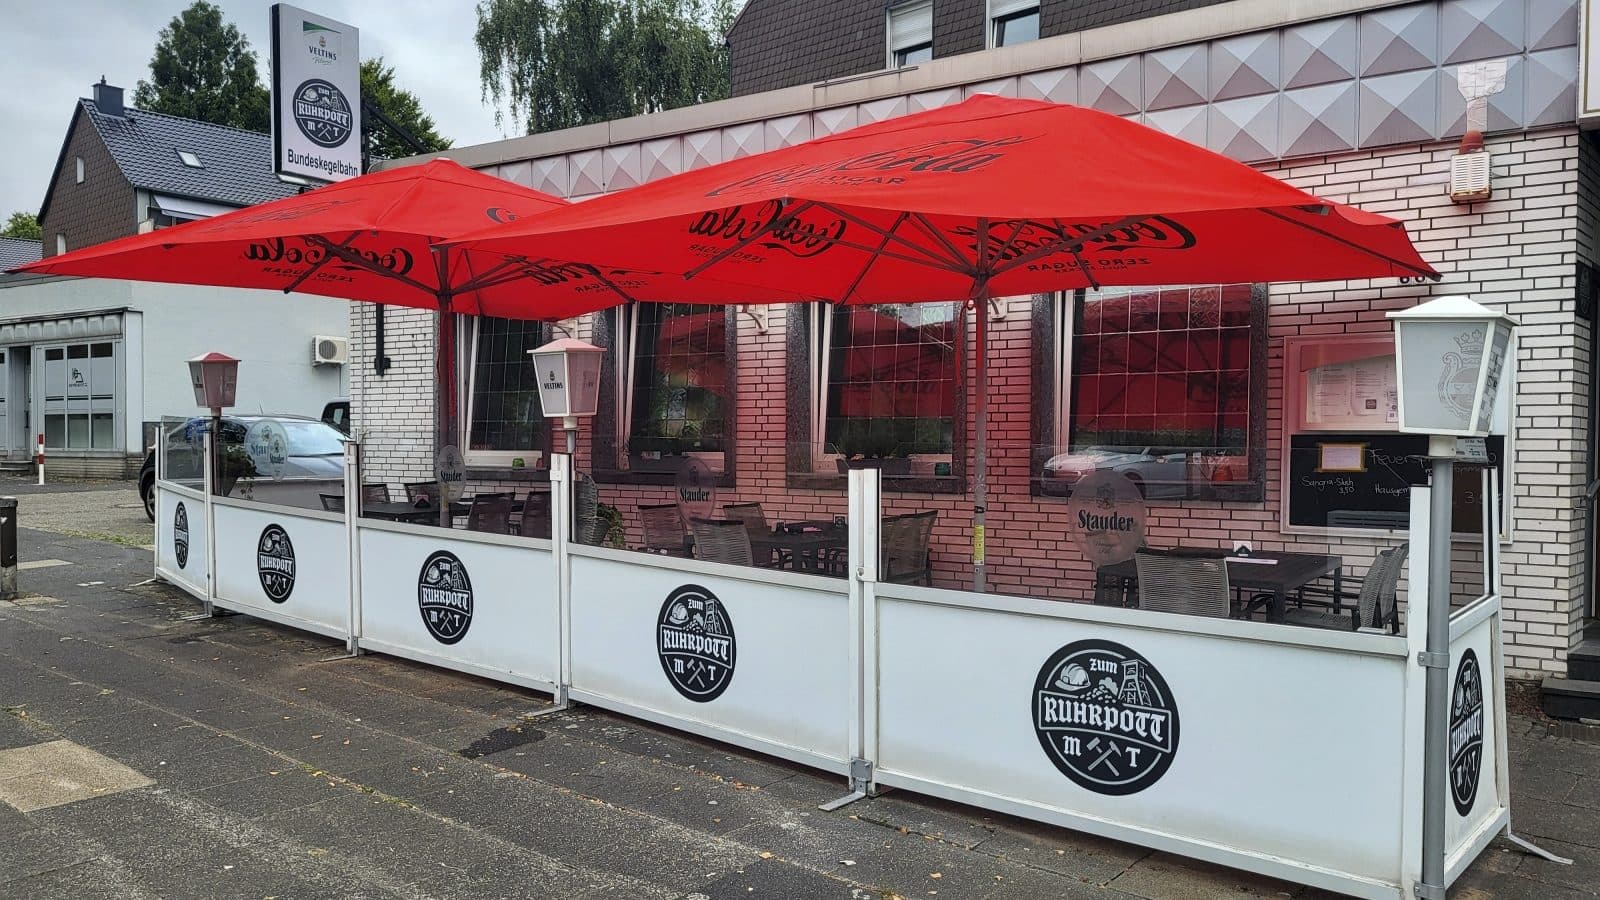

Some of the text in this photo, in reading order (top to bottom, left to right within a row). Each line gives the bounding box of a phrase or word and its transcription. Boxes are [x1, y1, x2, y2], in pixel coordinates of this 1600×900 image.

[309, 46, 337, 61] VELTINS
[287, 149, 358, 177] Bundeskegelbahn
[680, 487, 710, 503] Stauder
[1078, 509, 1134, 531] Stauder
